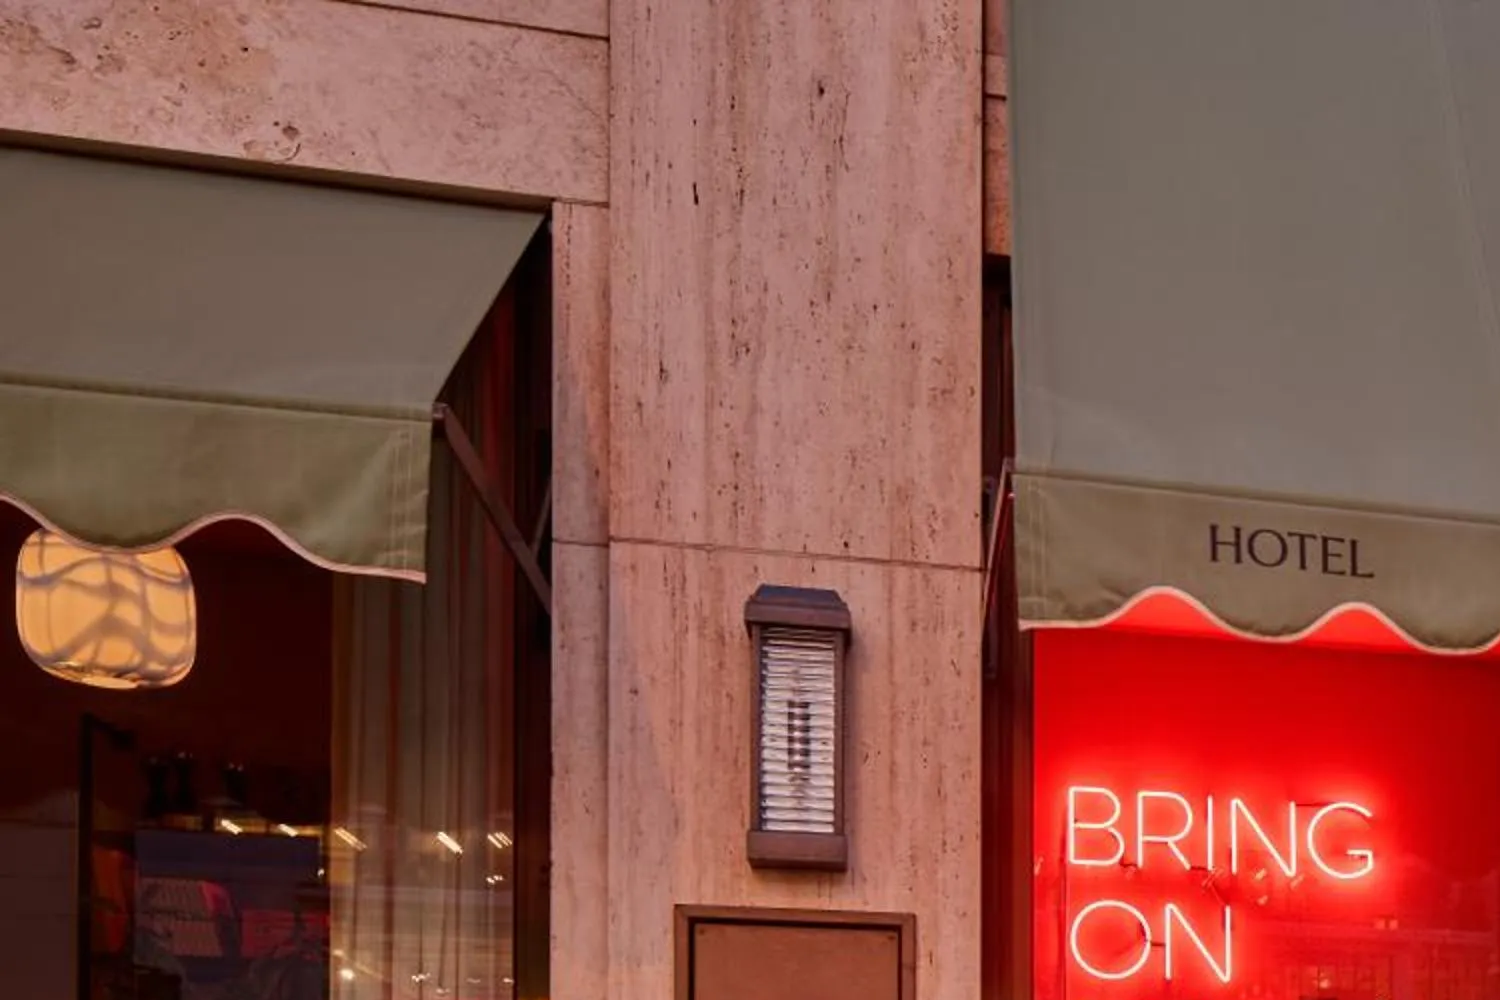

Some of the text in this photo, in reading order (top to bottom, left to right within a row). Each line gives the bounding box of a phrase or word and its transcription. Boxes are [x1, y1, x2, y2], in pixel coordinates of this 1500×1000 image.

[1209, 524, 1375, 579] HOTEL
[1067, 785, 1374, 880] BRING
[1069, 899, 1234, 984] ON
